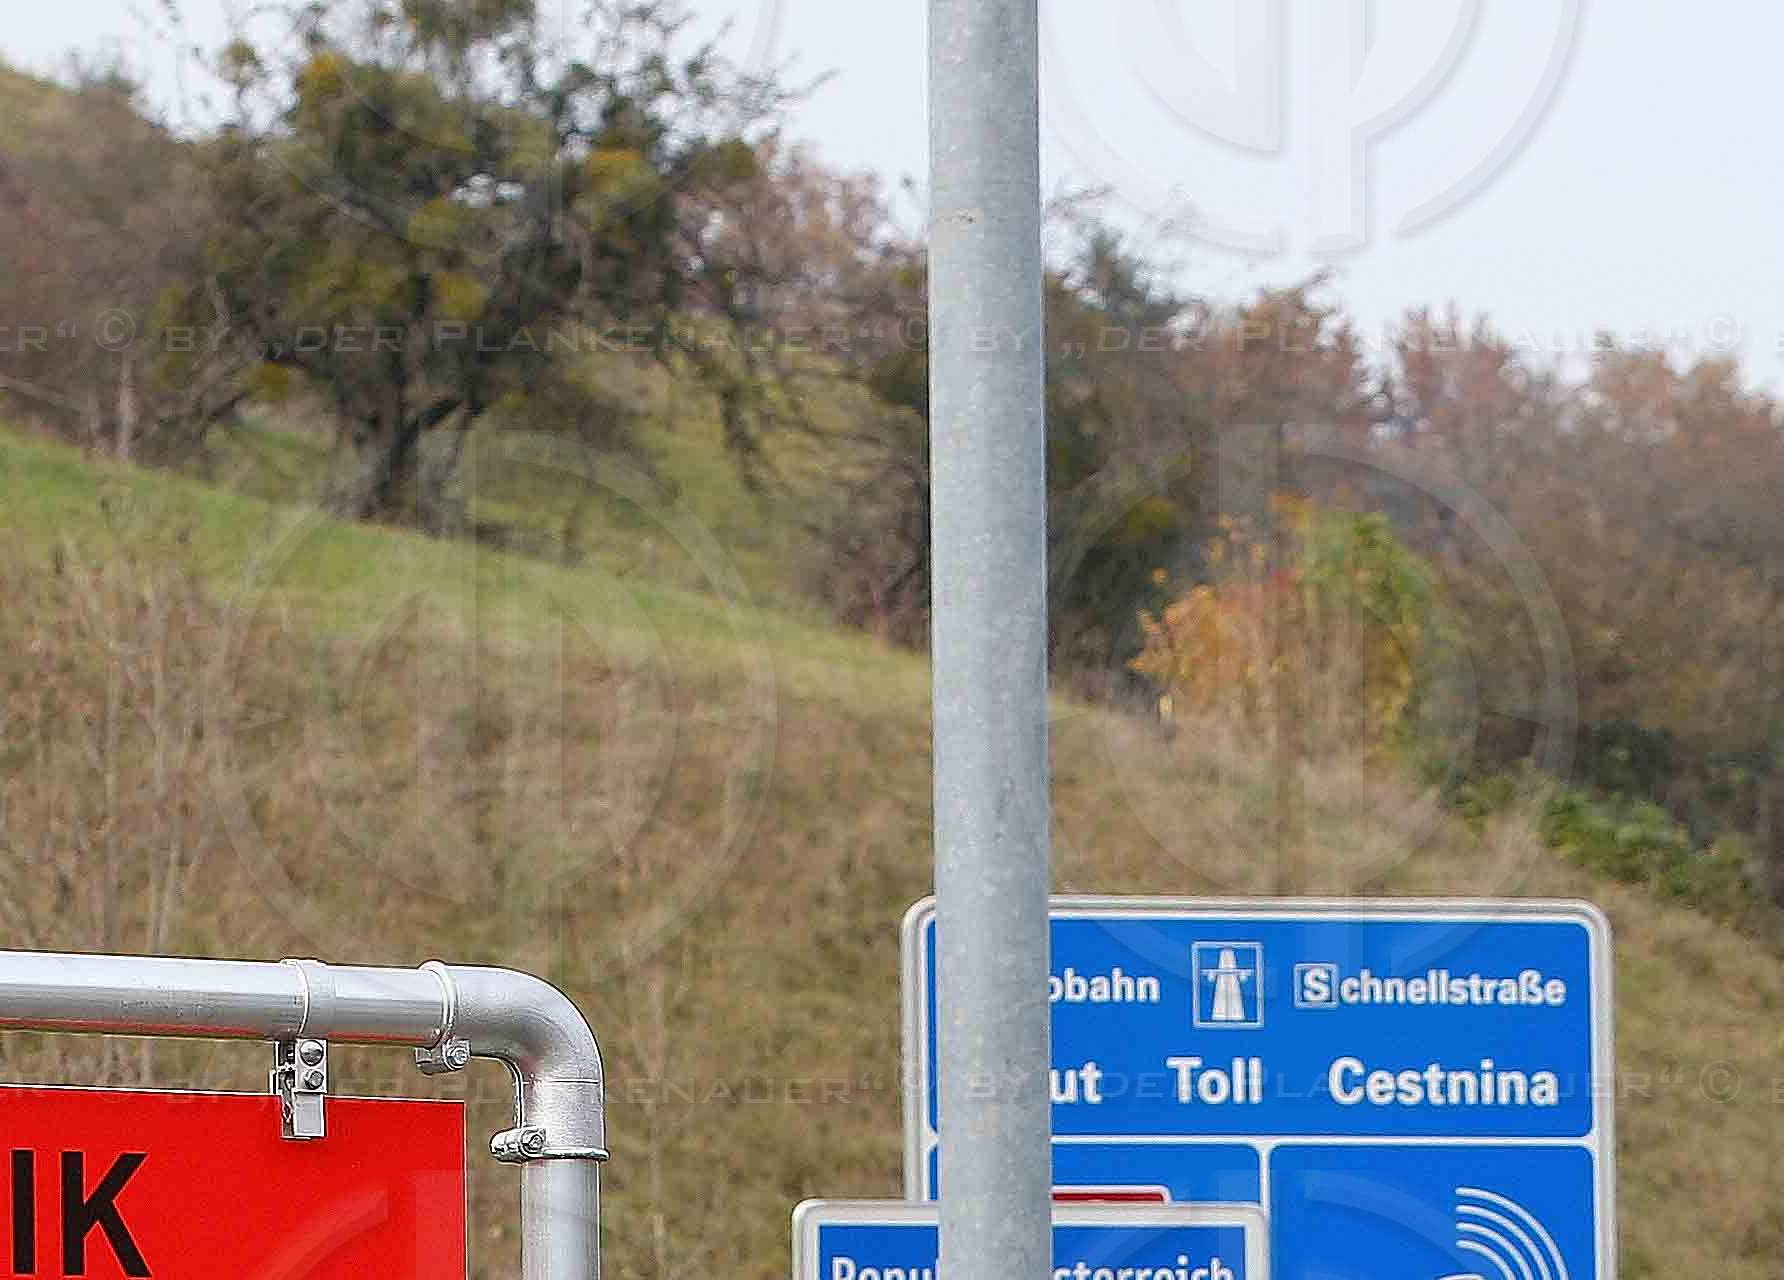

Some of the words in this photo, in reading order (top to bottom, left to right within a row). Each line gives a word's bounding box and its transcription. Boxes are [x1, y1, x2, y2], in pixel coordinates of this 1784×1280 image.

[1047, 967, 1161, 1002] obahn
[1303, 967, 1567, 1005] Schnellstraße
[1048, 1060, 1103, 1105] ut
[1165, 1055, 1264, 1105] Toll
[1327, 1055, 1559, 1105] Cestnina
